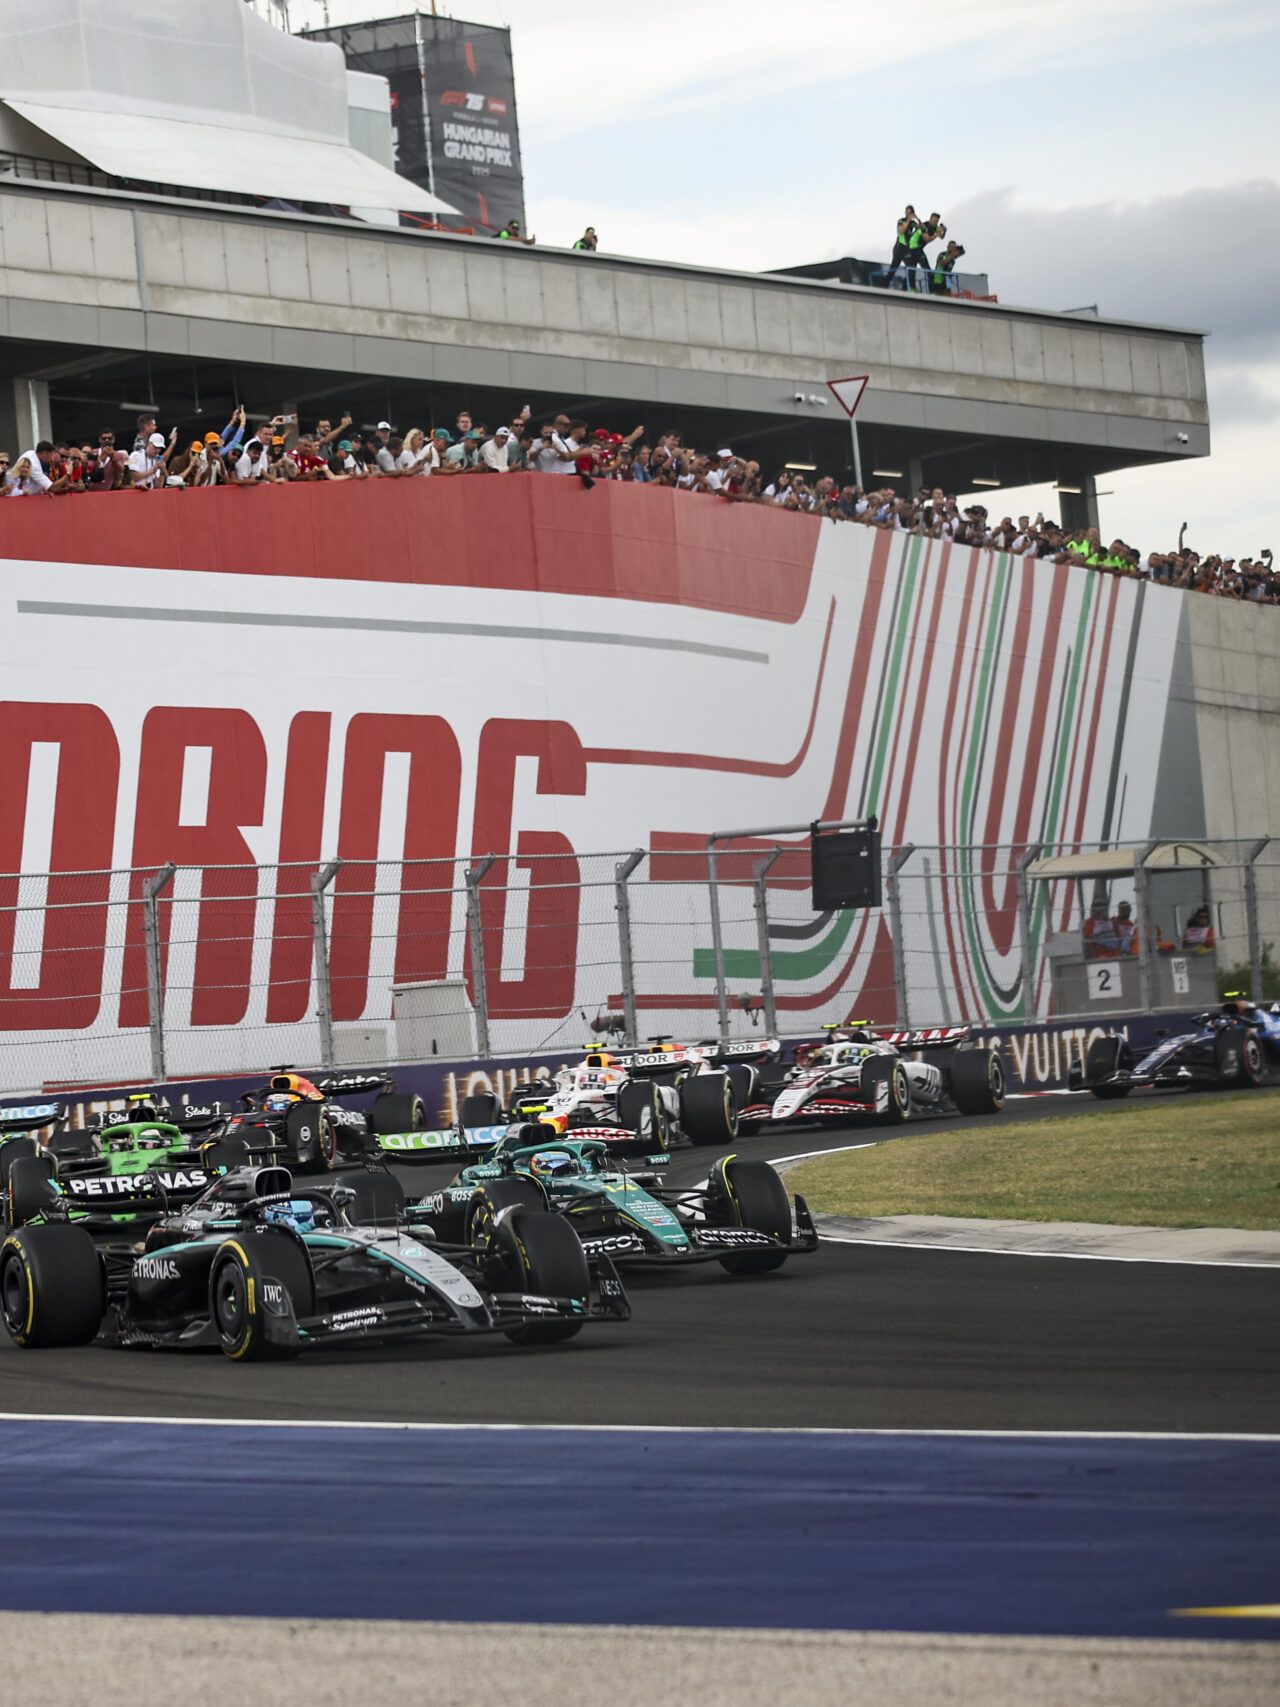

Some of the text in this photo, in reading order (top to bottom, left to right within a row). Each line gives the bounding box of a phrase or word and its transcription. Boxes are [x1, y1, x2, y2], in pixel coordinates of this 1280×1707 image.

[443, 122, 511, 150] HUNGARIAN
[444, 141, 513, 168] GRAND PRIX
[1098, 969, 1111, 991] 2
[622, 1052, 669, 1068] UDOR
[185, 1105, 211, 1118] Stake
[572, 1128, 630, 1140] HUGO
[70, 1169, 208, 1196] PETRONAS
[479, 1170, 500, 1178] BOSS
[131, 1258, 181, 1279] ETRONAS
[263, 1284, 282, 1303] IWC
[332, 1306, 377, 1322] PETRONAS
